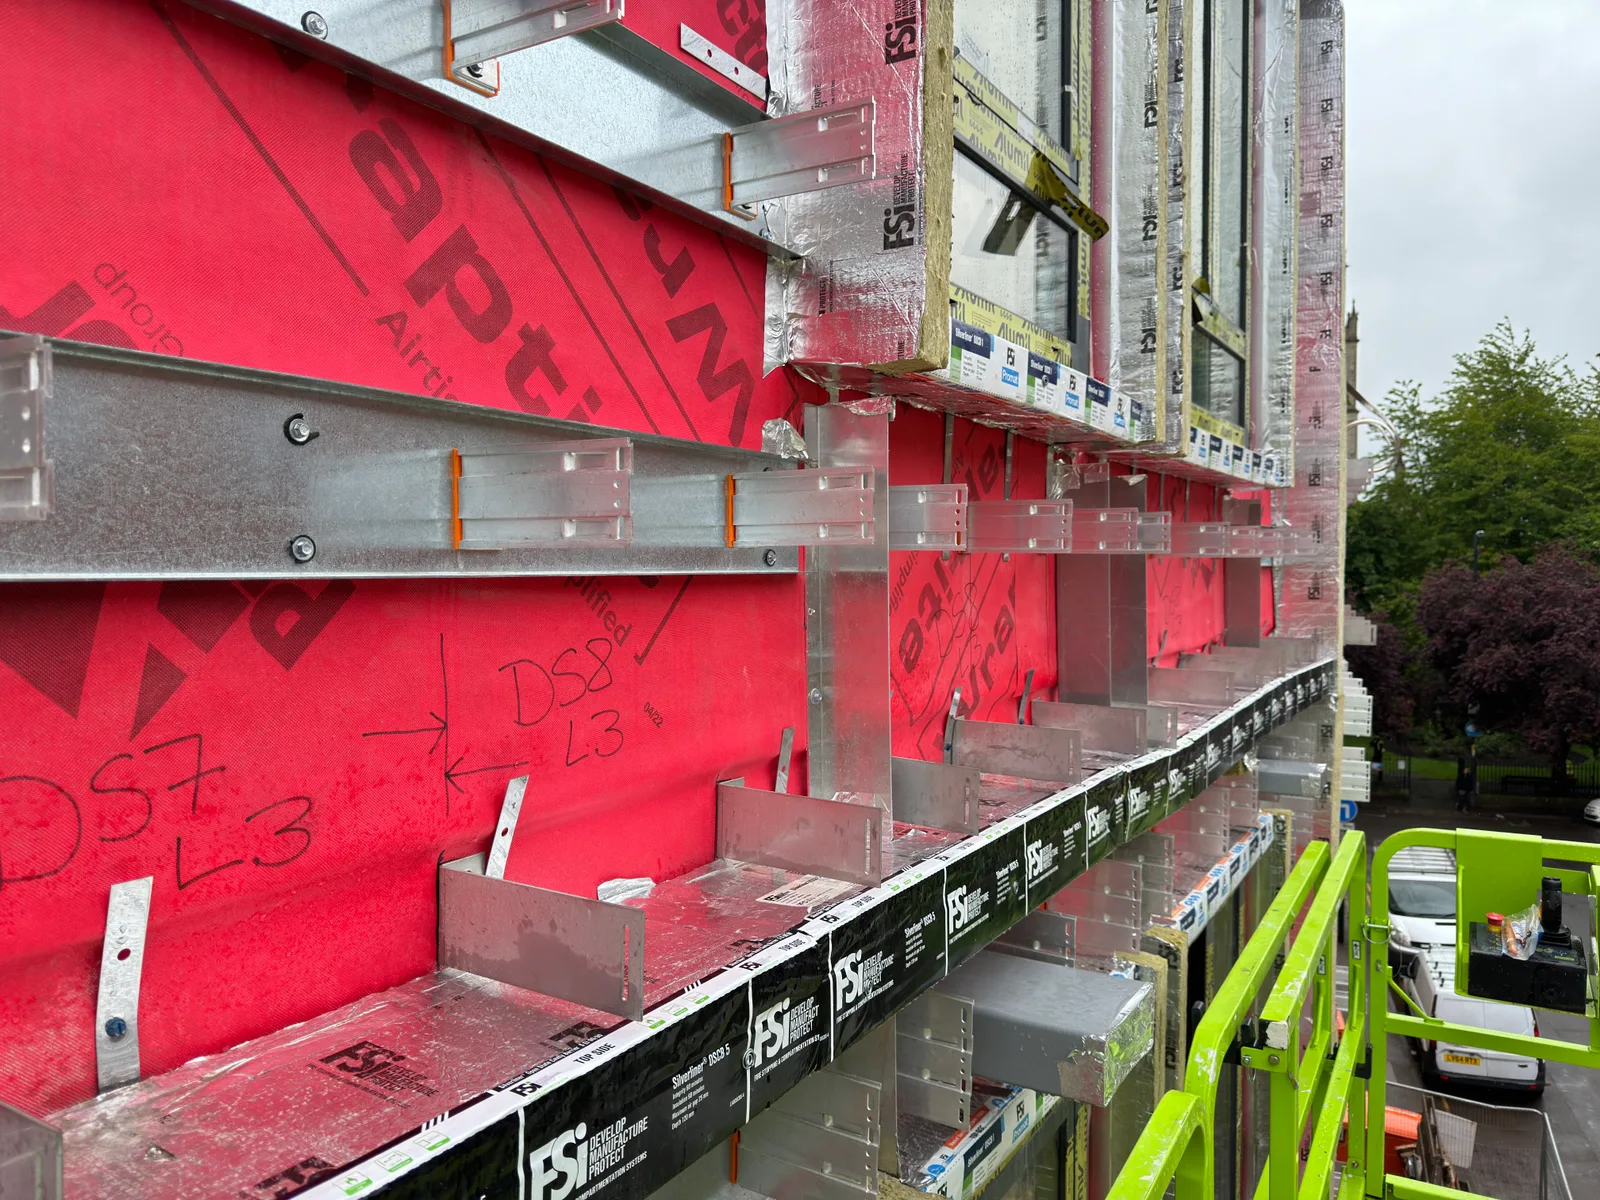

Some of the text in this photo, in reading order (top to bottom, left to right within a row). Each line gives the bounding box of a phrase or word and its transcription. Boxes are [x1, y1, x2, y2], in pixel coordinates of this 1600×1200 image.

[885, 15, 916, 64] FSi
[884, 204, 916, 250] FSi
[375, 309, 459, 401] Airti
[498, 638, 613, 726] DS8
[642, 702, 666, 729] 04/22
[0, 734, 226, 886] DS7
[1027, 839, 1042, 880] FSi
[947, 884, 967, 935] FSi
[834, 949, 863, 1011] FSi
[790, 996, 815, 1021] DEVELOP
[790, 1004, 820, 1032] MANUFACT
[754, 997, 790, 1068] FSi
[790, 1019, 814, 1044] PROTECT
[319, 1040, 406, 1079] FSi
[573, 1042, 616, 1064] TOP SIDE
[708, 1046, 725, 1067] OSCB
[725, 1042, 731, 1056] 5
[510, 1081, 542, 1097] FSi
[589, 1115, 648, 1166] MANUFACTURE
[590, 1116, 626, 1151] DEVELOP
[530, 1122, 588, 1200] FSi
[588, 1144, 625, 1180] PROTECT
[625, 1150, 648, 1172] SYSTEMS
